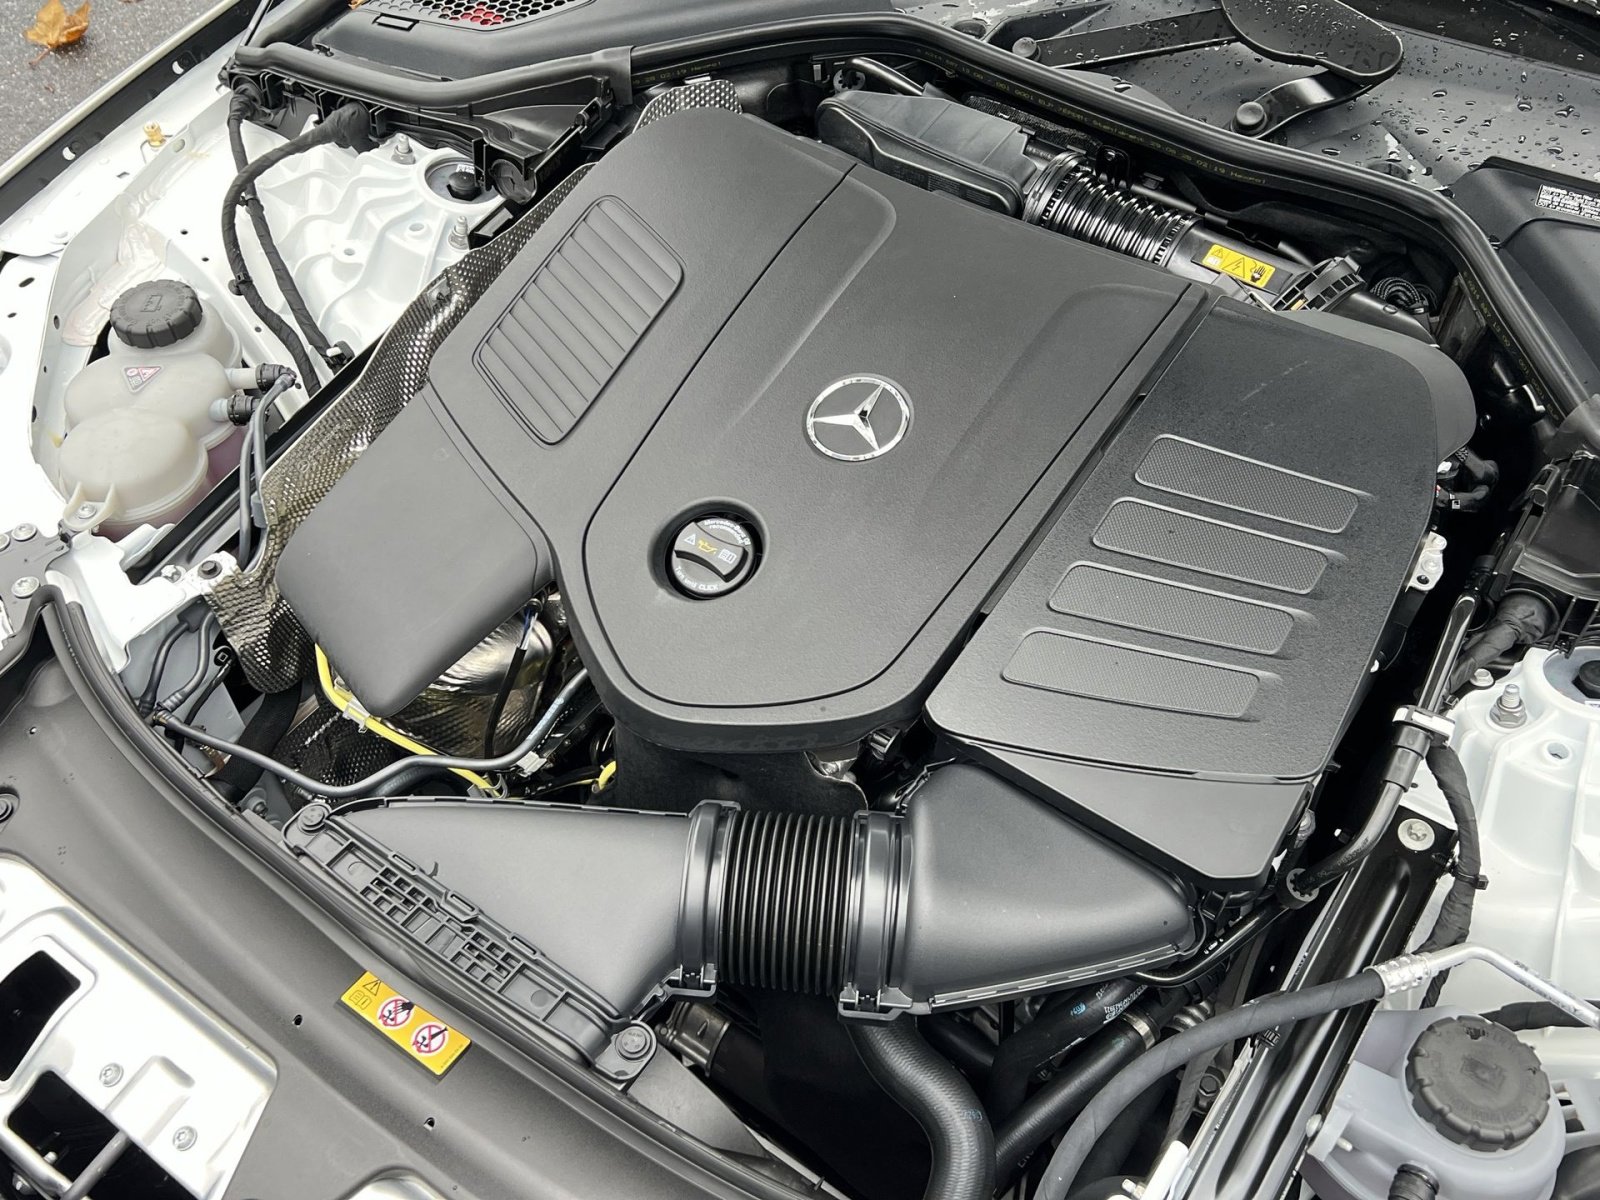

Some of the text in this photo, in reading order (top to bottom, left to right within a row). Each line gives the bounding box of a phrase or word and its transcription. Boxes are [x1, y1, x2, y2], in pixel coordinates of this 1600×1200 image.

[704, 519, 747, 540] Mercedes-Benz
[709, 524, 744, 545] recommended
[675, 565, 719, 592] Turn until CLICK
